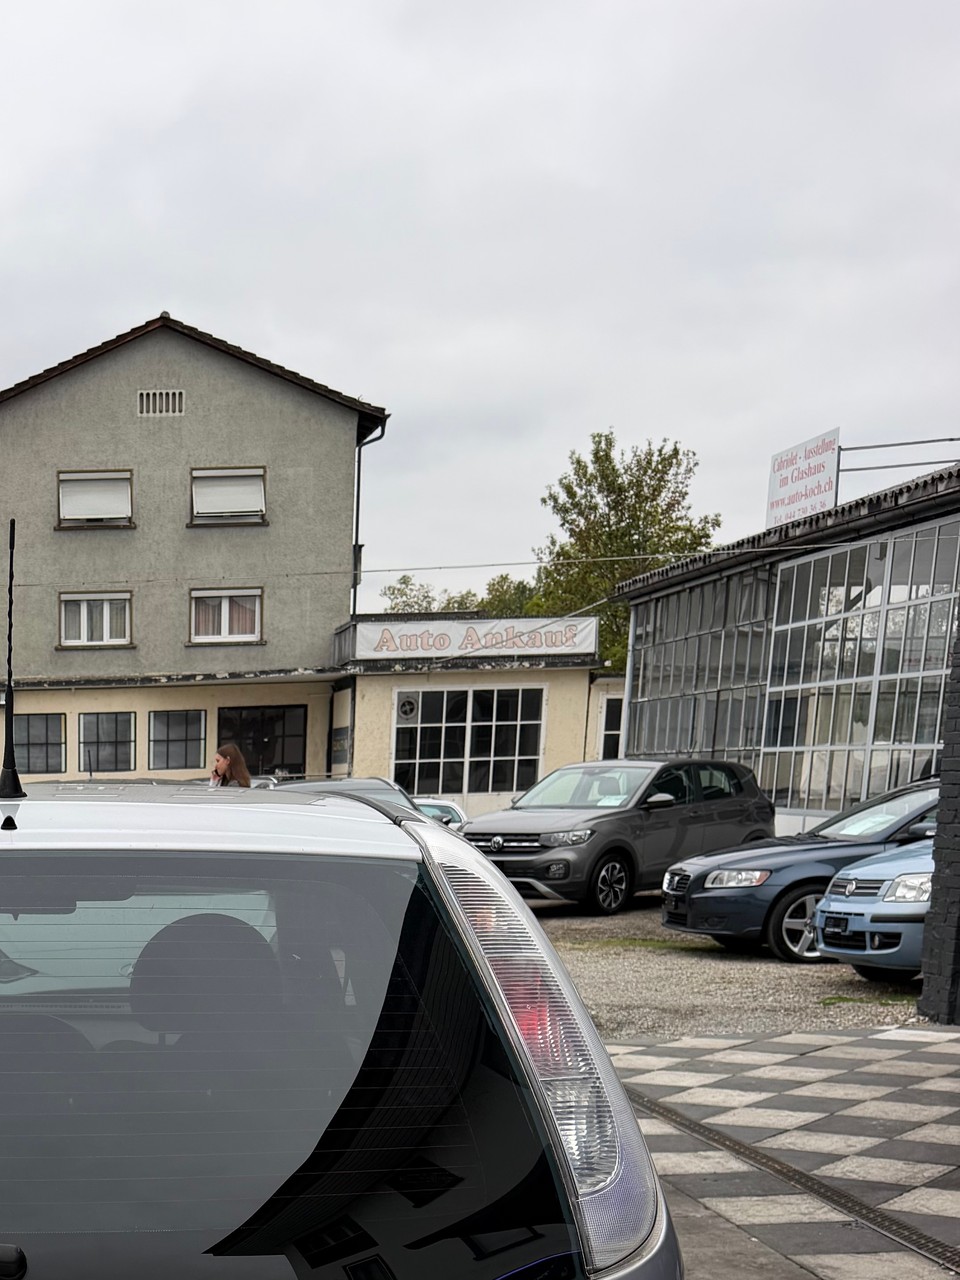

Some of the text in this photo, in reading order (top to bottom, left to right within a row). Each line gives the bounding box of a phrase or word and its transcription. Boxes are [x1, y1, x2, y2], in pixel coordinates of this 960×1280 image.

[779, 462, 825, 488] im Glashaus
[770, 477, 833, 510] www.auto-koch.ch
[373, 624, 577, 652] Auto Ankauf
